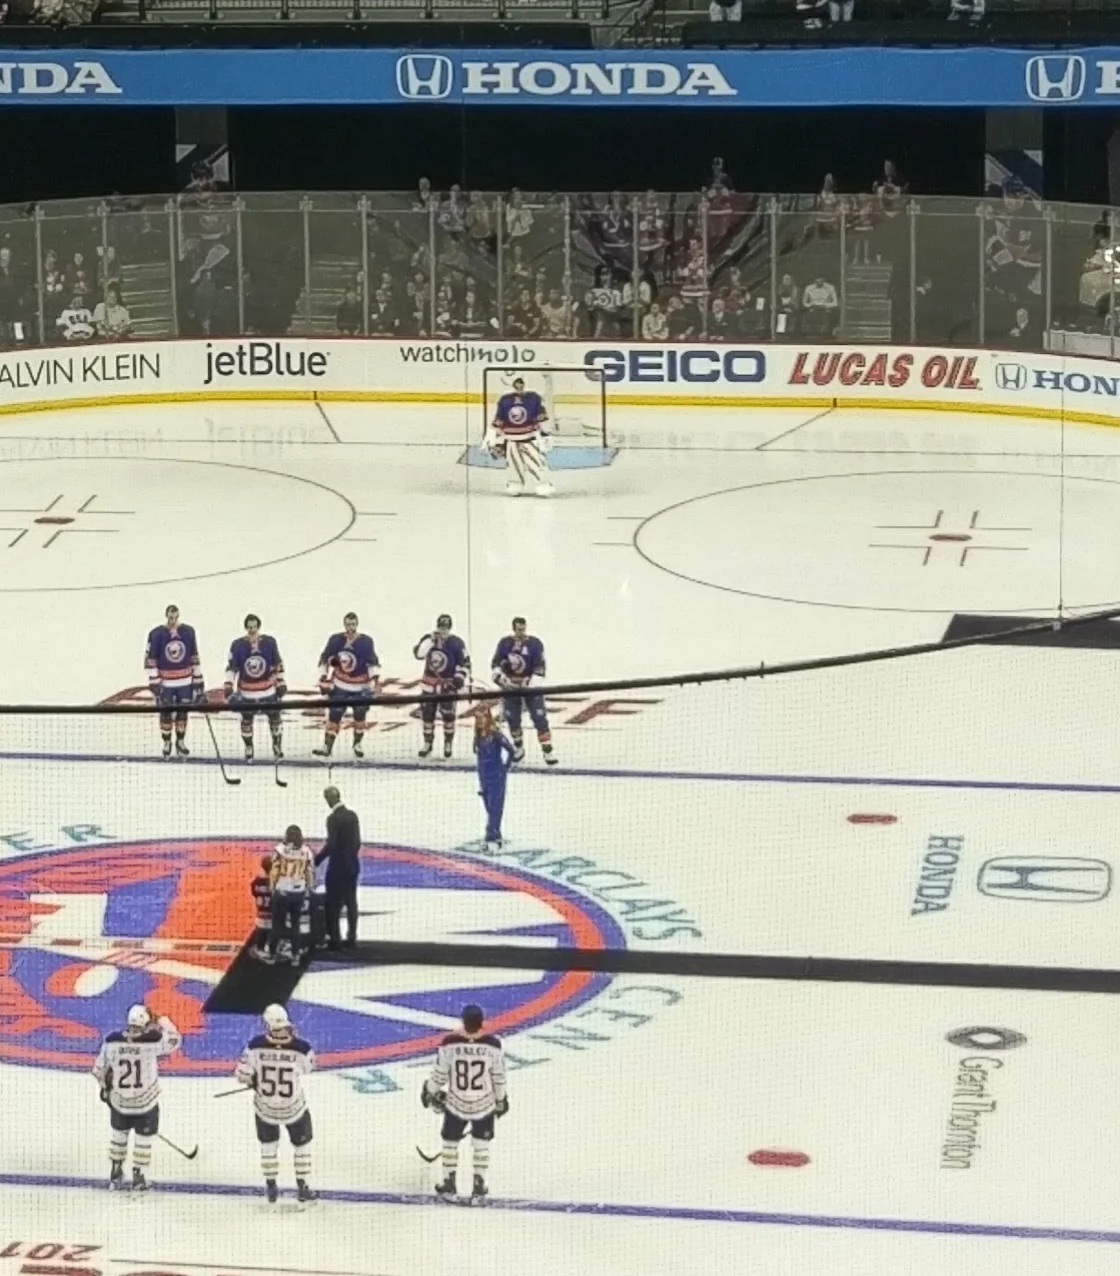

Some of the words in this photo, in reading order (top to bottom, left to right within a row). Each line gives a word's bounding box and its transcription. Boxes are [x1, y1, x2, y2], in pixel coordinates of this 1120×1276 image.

[462, 61, 738, 96] HONDA
[82, 352, 162, 383] KLEIN
[203, 342, 329, 384] jetBlue
[583, 350, 767, 383] GEICO
[787, 352, 915, 387] LUCAS
[921, 355, 982, 390] OIL
[910, 834, 965, 917] HONDA
[118, 1058, 143, 1089] 21
[260, 1065, 294, 1098] 55
[454, 1059, 485, 1091] 82
